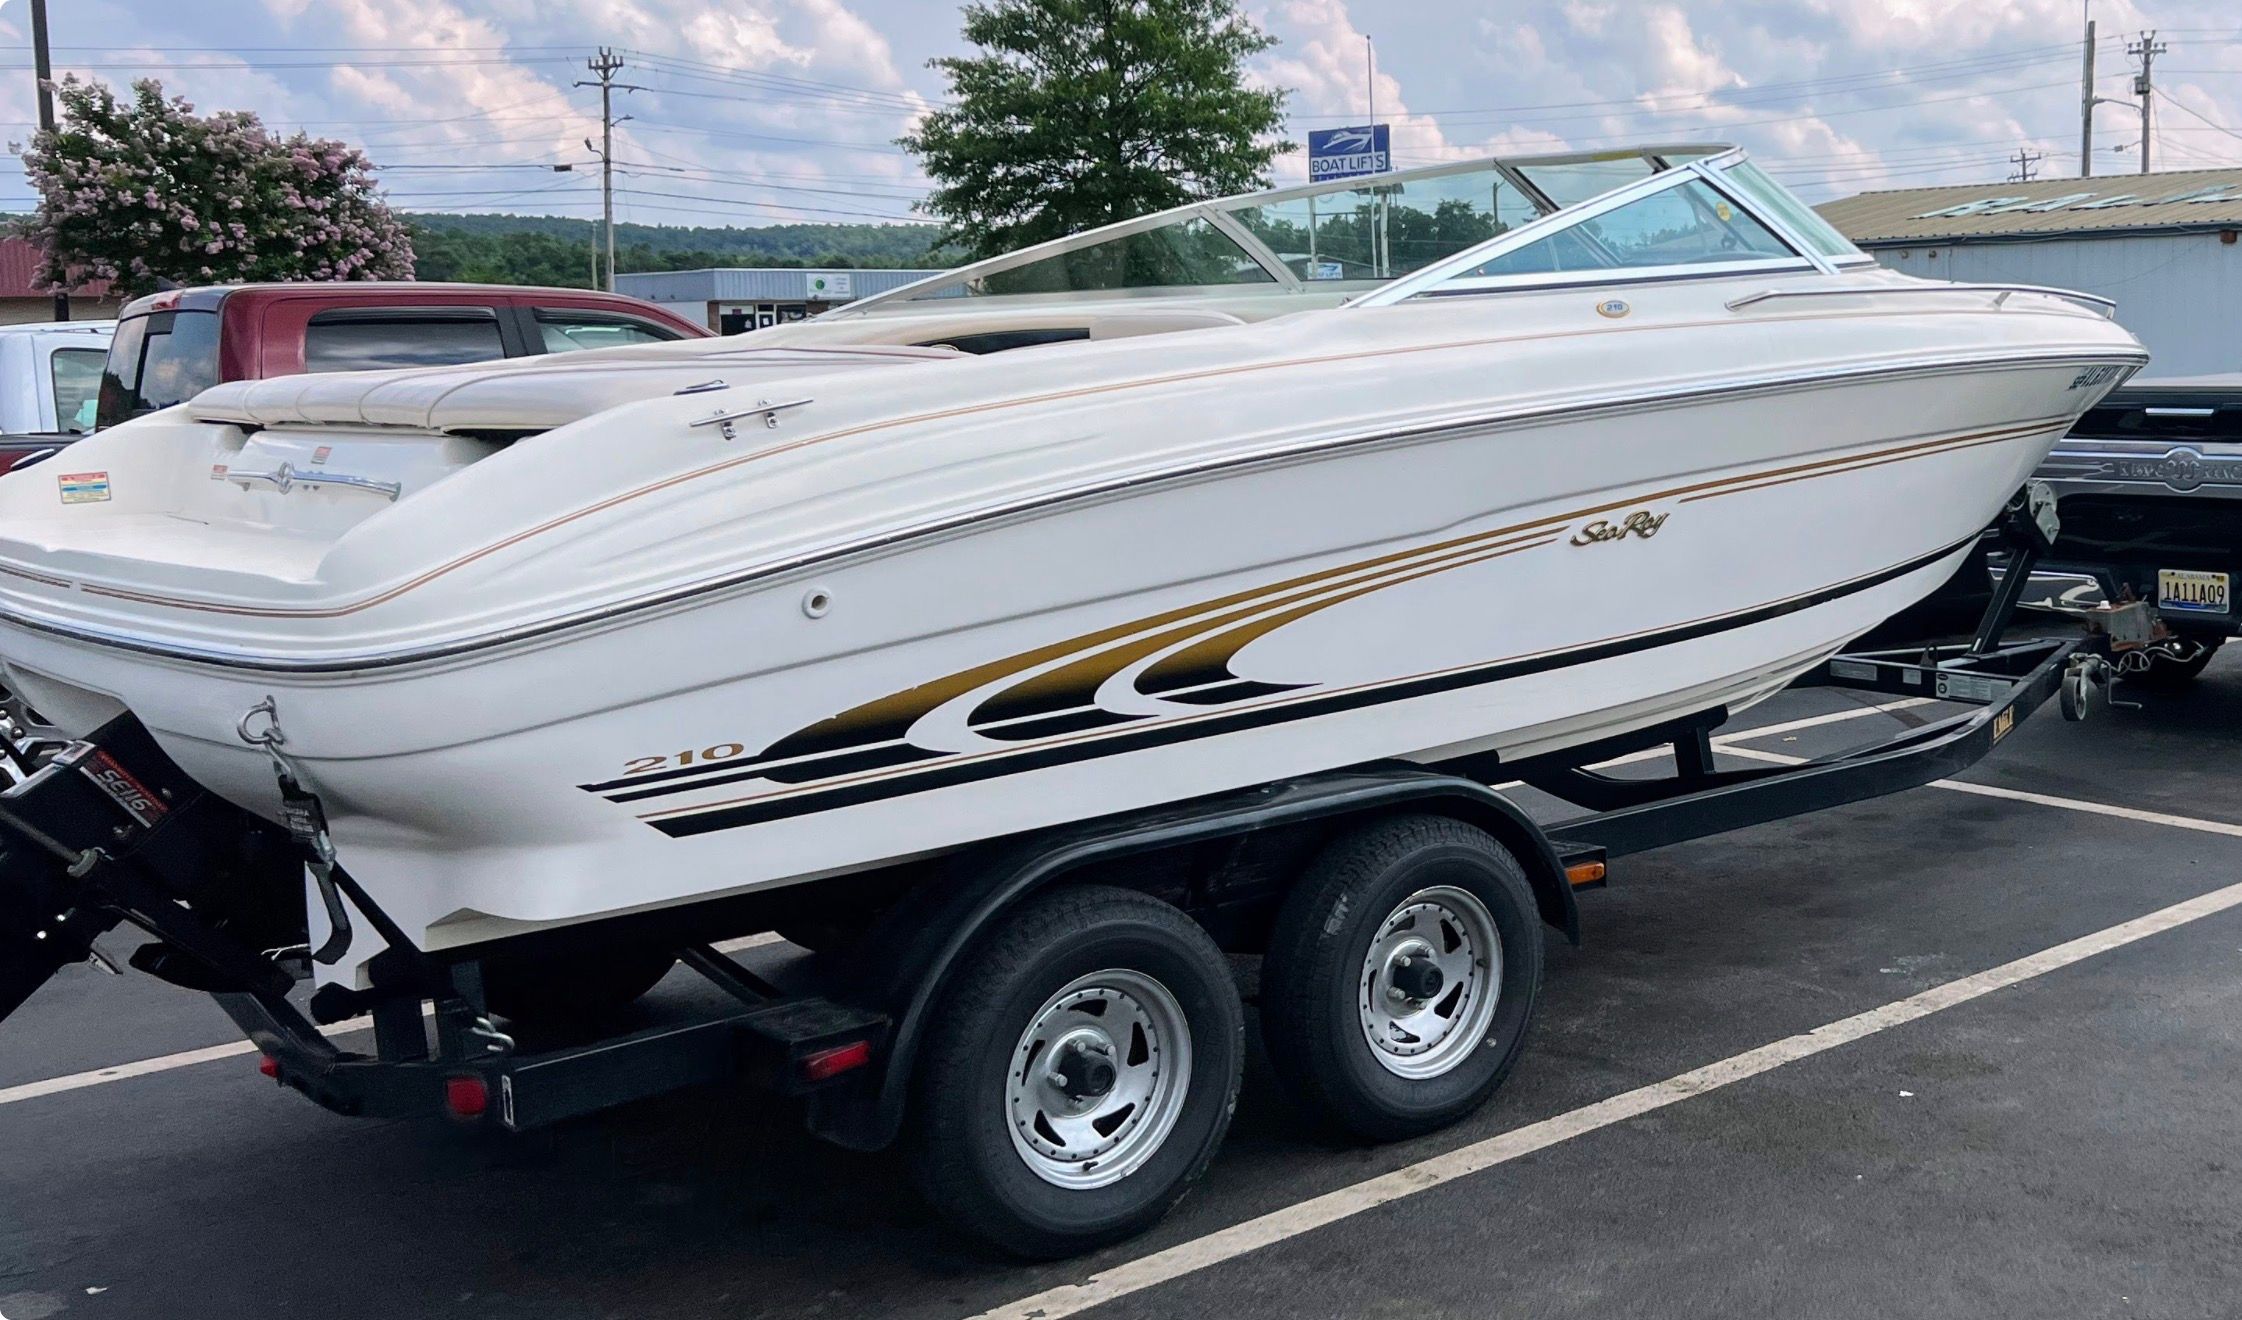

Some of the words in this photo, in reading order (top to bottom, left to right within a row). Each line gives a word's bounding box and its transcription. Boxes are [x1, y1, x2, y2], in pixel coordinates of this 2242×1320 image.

[1312, 158, 1346, 173] BOAT
[1349, 154, 1384, 171] LIFTS
[1570, 520, 1618, 547] Sea
[1616, 510, 1671, 540] Ray
[2164, 581, 2225, 605] 1A11A09
[623, 743, 744, 776] 210
